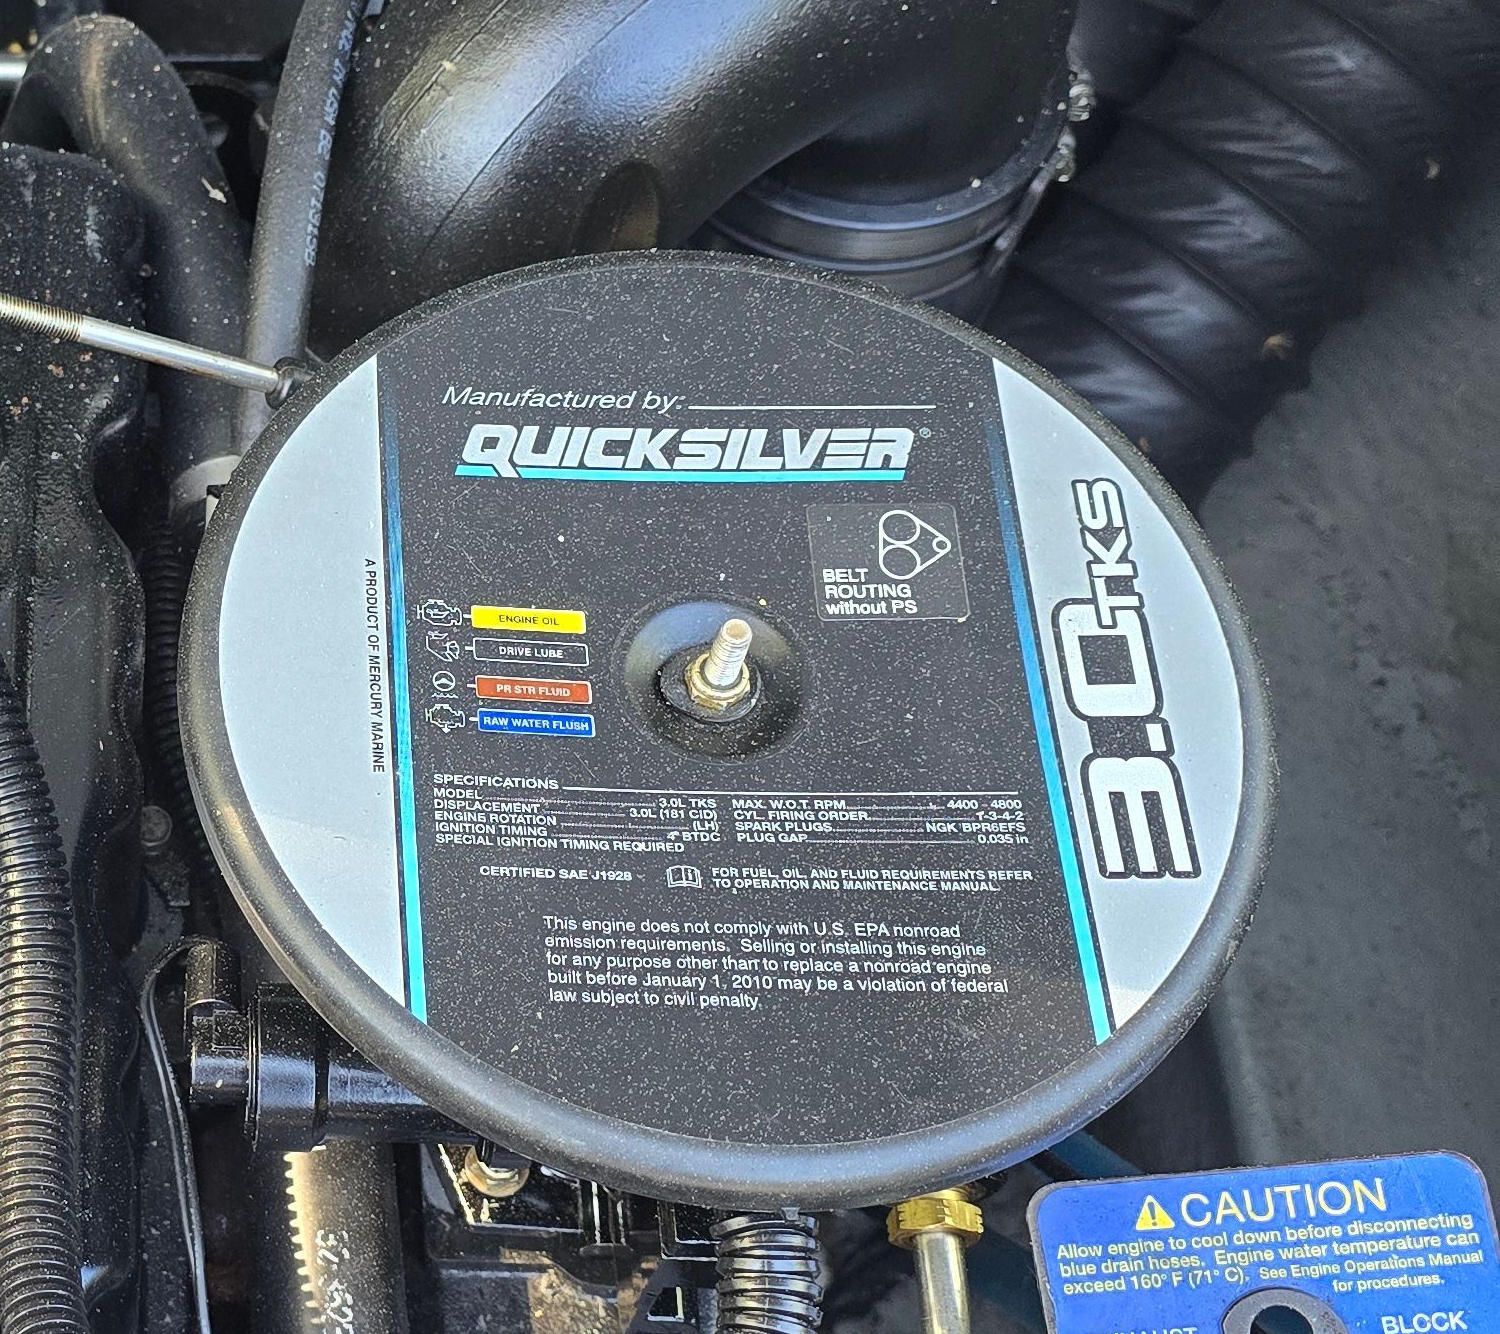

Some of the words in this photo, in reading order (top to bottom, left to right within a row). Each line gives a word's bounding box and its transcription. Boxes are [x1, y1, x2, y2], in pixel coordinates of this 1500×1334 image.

[442, 386, 637, 409] Manufactured
[642, 391, 686, 415] by:
[461, 423, 915, 478] QUICKSILVER
[364, 558, 376, 567] A
[823, 568, 868, 583] BELT
[365, 570, 379, 631] PRODUCT
[825, 584, 912, 599] ROUTING
[825, 601, 888, 615] without
[892, 600, 918, 614] PS
[499, 614, 538, 625] ENGINE
[542, 617, 560, 626] OIL
[367, 634, 380, 652] OF
[499, 645, 531, 657] DRIVE
[534, 648, 564, 659] LUBE
[368, 655, 383, 718] MERCURY
[497, 684, 512, 694] PR
[514, 685, 536, 695] STR
[538, 686, 571, 697] FLUID
[483, 716, 509, 726] RAW
[511, 718, 550, 729] WATER
[552, 720, 590, 731] FLUSH
[371, 721, 385, 772] MARINE
[433, 773, 559, 790] SPECIFICATIONS
[434, 799, 541, 813] DISPLACEMENT
[629, 808, 657, 818] 3.0L
[659, 808, 687, 819] (181
[690, 808, 718, 820] CID)
[435, 833, 493, 846] SPECIAL
[497, 837, 558, 849] IGNITION
[561, 839, 610, 851] TIMING
[613, 841, 685, 852] REQUIRED
[480, 866, 552, 879] CERTIFIED
[558, 869, 589, 880] SAE
[592, 869, 632, 881] J1928
[543, 916, 577, 930] This
[582, 920, 635, 934] engine
[640, 919, 679, 932] does
[684, 921, 710, 933] not
[714, 922, 771, 937] comply
[776, 922, 809, 935] with
[854, 923, 890, 936] EPA
[893, 924, 960, 938] nonroad
[544, 935, 616, 949] emission
[741, 938, 795, 956] Selling
[800, 943, 817, 954] or
[822, 940, 892, 958] installing
[898, 942, 927, 955] this
[931, 944, 986, 958] engine
[546, 952, 567, 965] for
[572, 955, 600, 968] any
[606, 955, 671, 970] purpose
[676, 955, 718, 969] other
[722, 957, 759, 970] than
[762, 958, 779, 971] to
[783, 959, 844, 974] replace
[848, 963, 860, 972] a
[864, 960, 932, 974] nonroad
[936, 962, 992, 977] engine
[547, 969, 582, 984] built
[586, 971, 638, 985] before
[642, 973, 706, 991] January
[731, 975, 773, 989] 2010
[777, 978, 812, 993] may
[817, 977, 838, 991] be
[843, 981, 854, 991] a
[857, 979, 927, 993] violation
[931, 979, 948, 992] of
[950, 979, 1009, 993] federal
[549, 988, 577, 1002] law
[581, 989, 641, 1007] subject
[643, 992, 660, 1005] to
[664, 992, 695, 1006] civil
[1181, 1178, 1387, 1227] CAUTION
[1057, 1243, 1102, 1259] Allow
[1108, 1238, 1164, 1257] engine
[1169, 1236, 1187, 1250] to
[1191, 1232, 1228, 1248] cool
[1233, 1229, 1281, 1245] down
[1285, 1223, 1342, 1241] before
[1347, 1212, 1474, 1237] disconnecting
[1059, 1262, 1097, 1278] blue
[1101, 1257, 1144, 1274] drain
[1147, 1253, 1205, 1270] hoses.
[1214, 1247, 1275, 1266] Engine
[1278, 1245, 1328, 1260] water
[1331, 1233, 1442, 1256] temperature
[1446, 1231, 1480, 1246] can
[1063, 1276, 1126, 1295] exceed
[1130, 1271, 1168, 1290] 160°
[1171, 1271, 1184, 1287] F
[1188, 1269, 1220, 1290] (71°
[1260, 1265, 1288, 1280] See
[1291, 1262, 1341, 1279] Engine
[1344, 1254, 1426, 1275] Operations
[1428, 1249, 1484, 1267] Manual
[1332, 1278, 1354, 1293] for
[1356, 1272, 1445, 1293] procedures.
